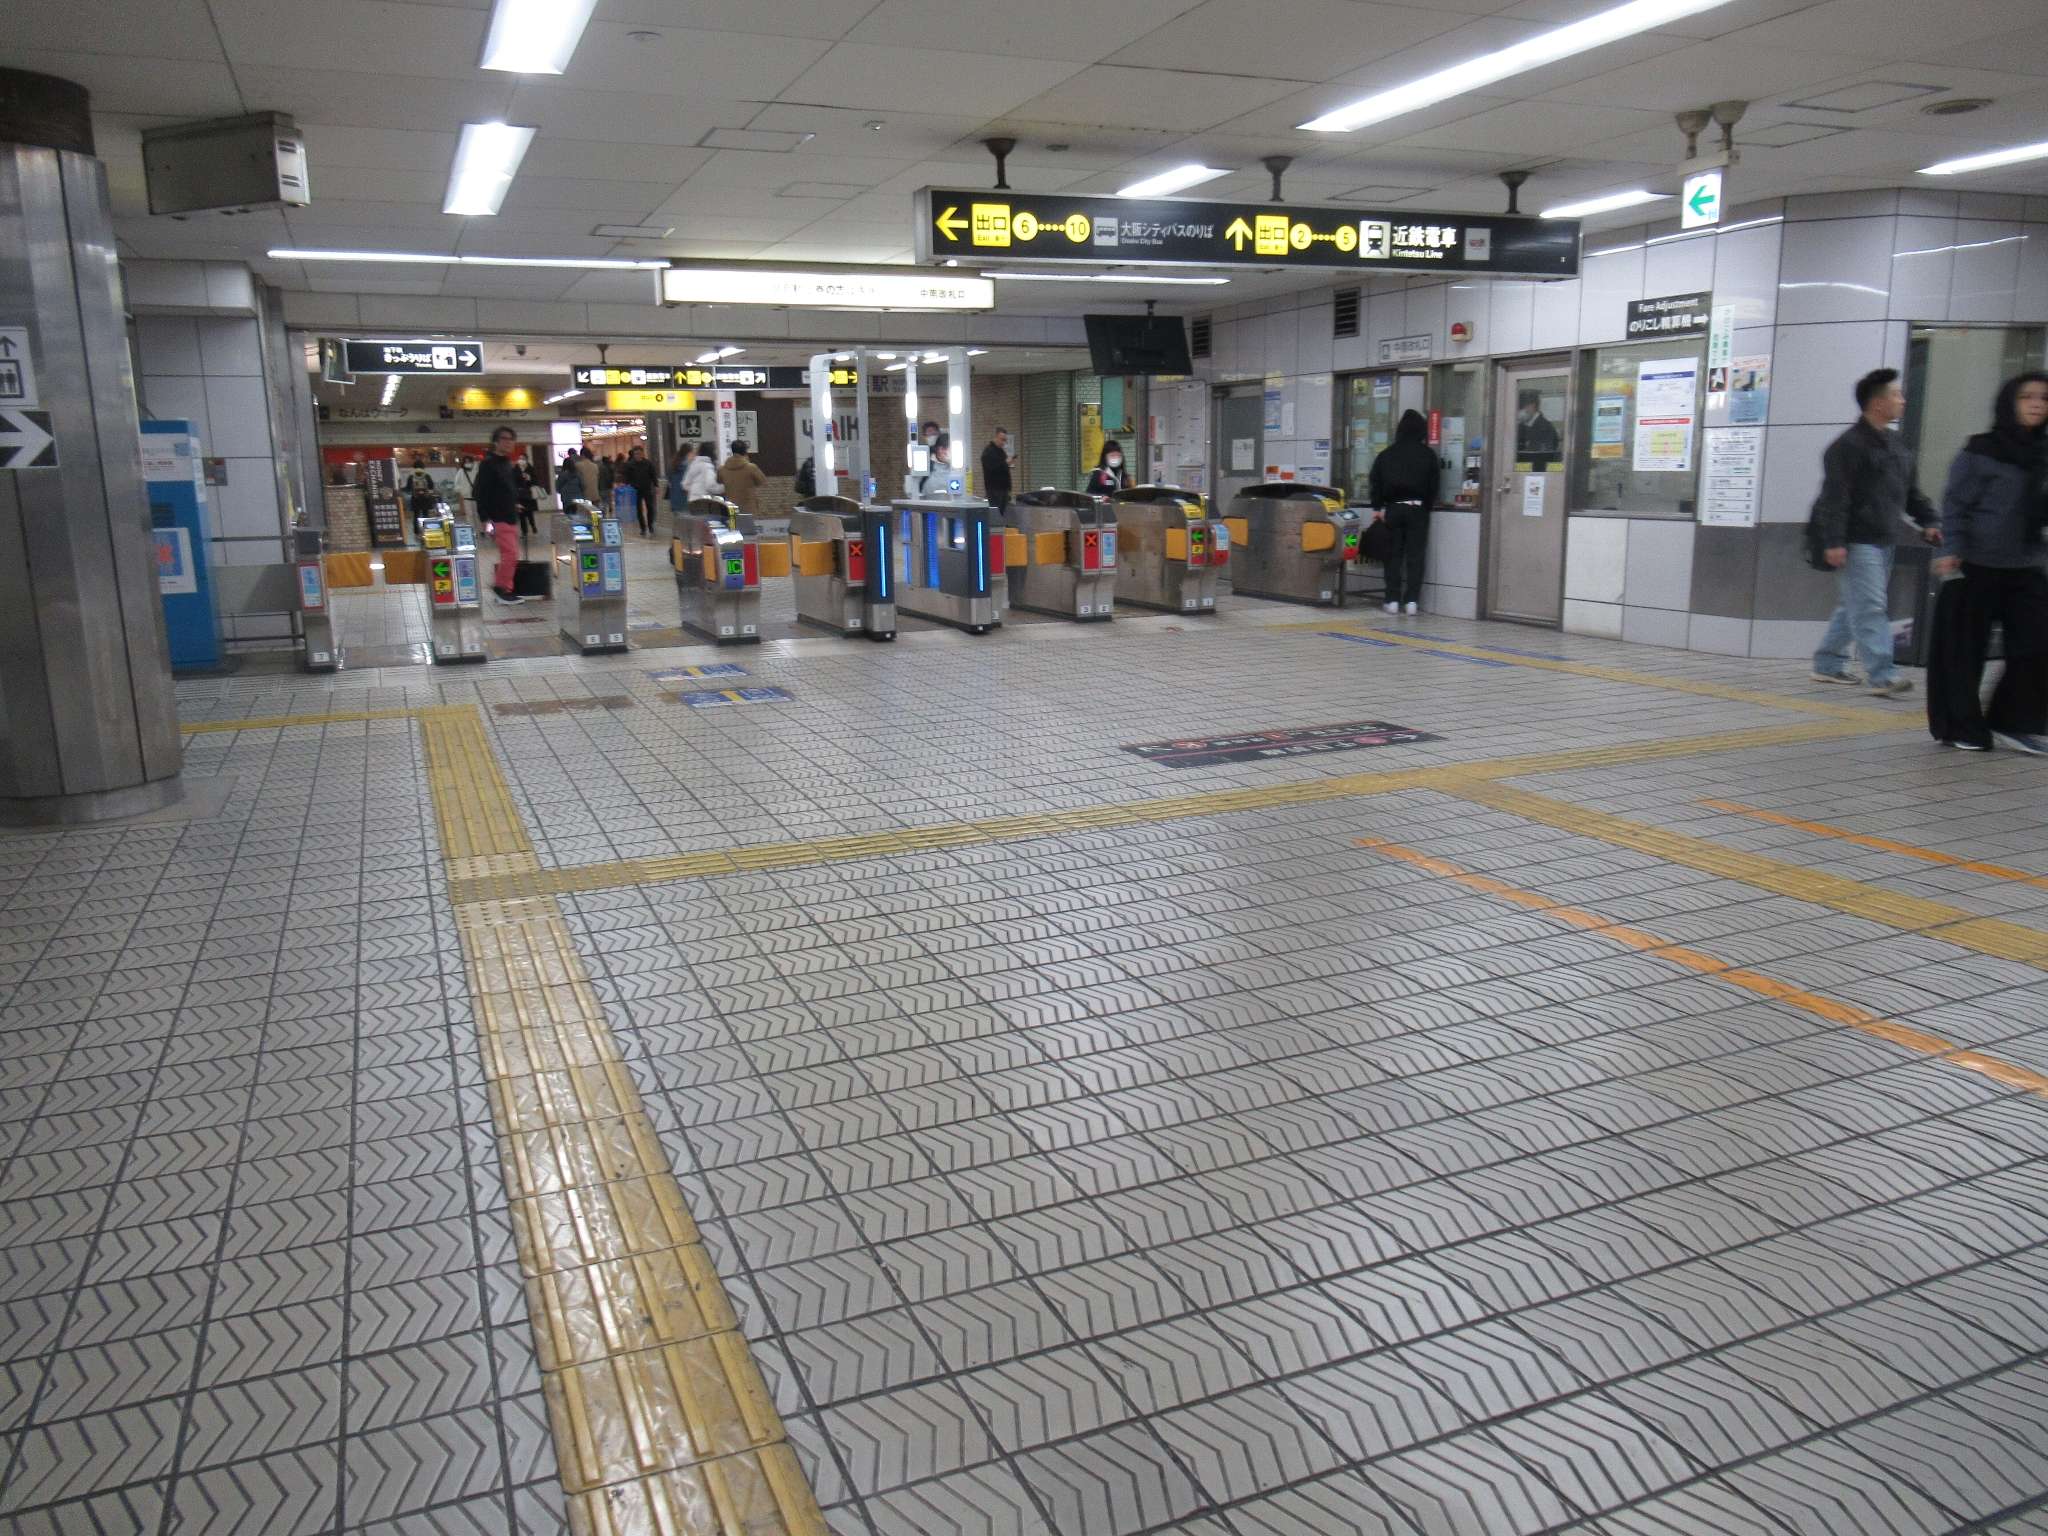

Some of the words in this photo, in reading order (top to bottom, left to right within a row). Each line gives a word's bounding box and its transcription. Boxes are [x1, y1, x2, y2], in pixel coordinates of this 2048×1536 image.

[976, 214, 1007, 231] 出口
[1021, 219, 1029, 234] 6
[1070, 221, 1086, 236] 10
[1120, 221, 1214, 239] 大阪シティバスのりば
[1259, 224, 1285, 240] 出口
[1297, 230, 1304, 243] 2
[1391, 225, 1457, 248] 近鉄電車
[1425, 250, 1443, 259] Line
[582, 554, 599, 569] IC
[727, 560, 742, 574] IC
